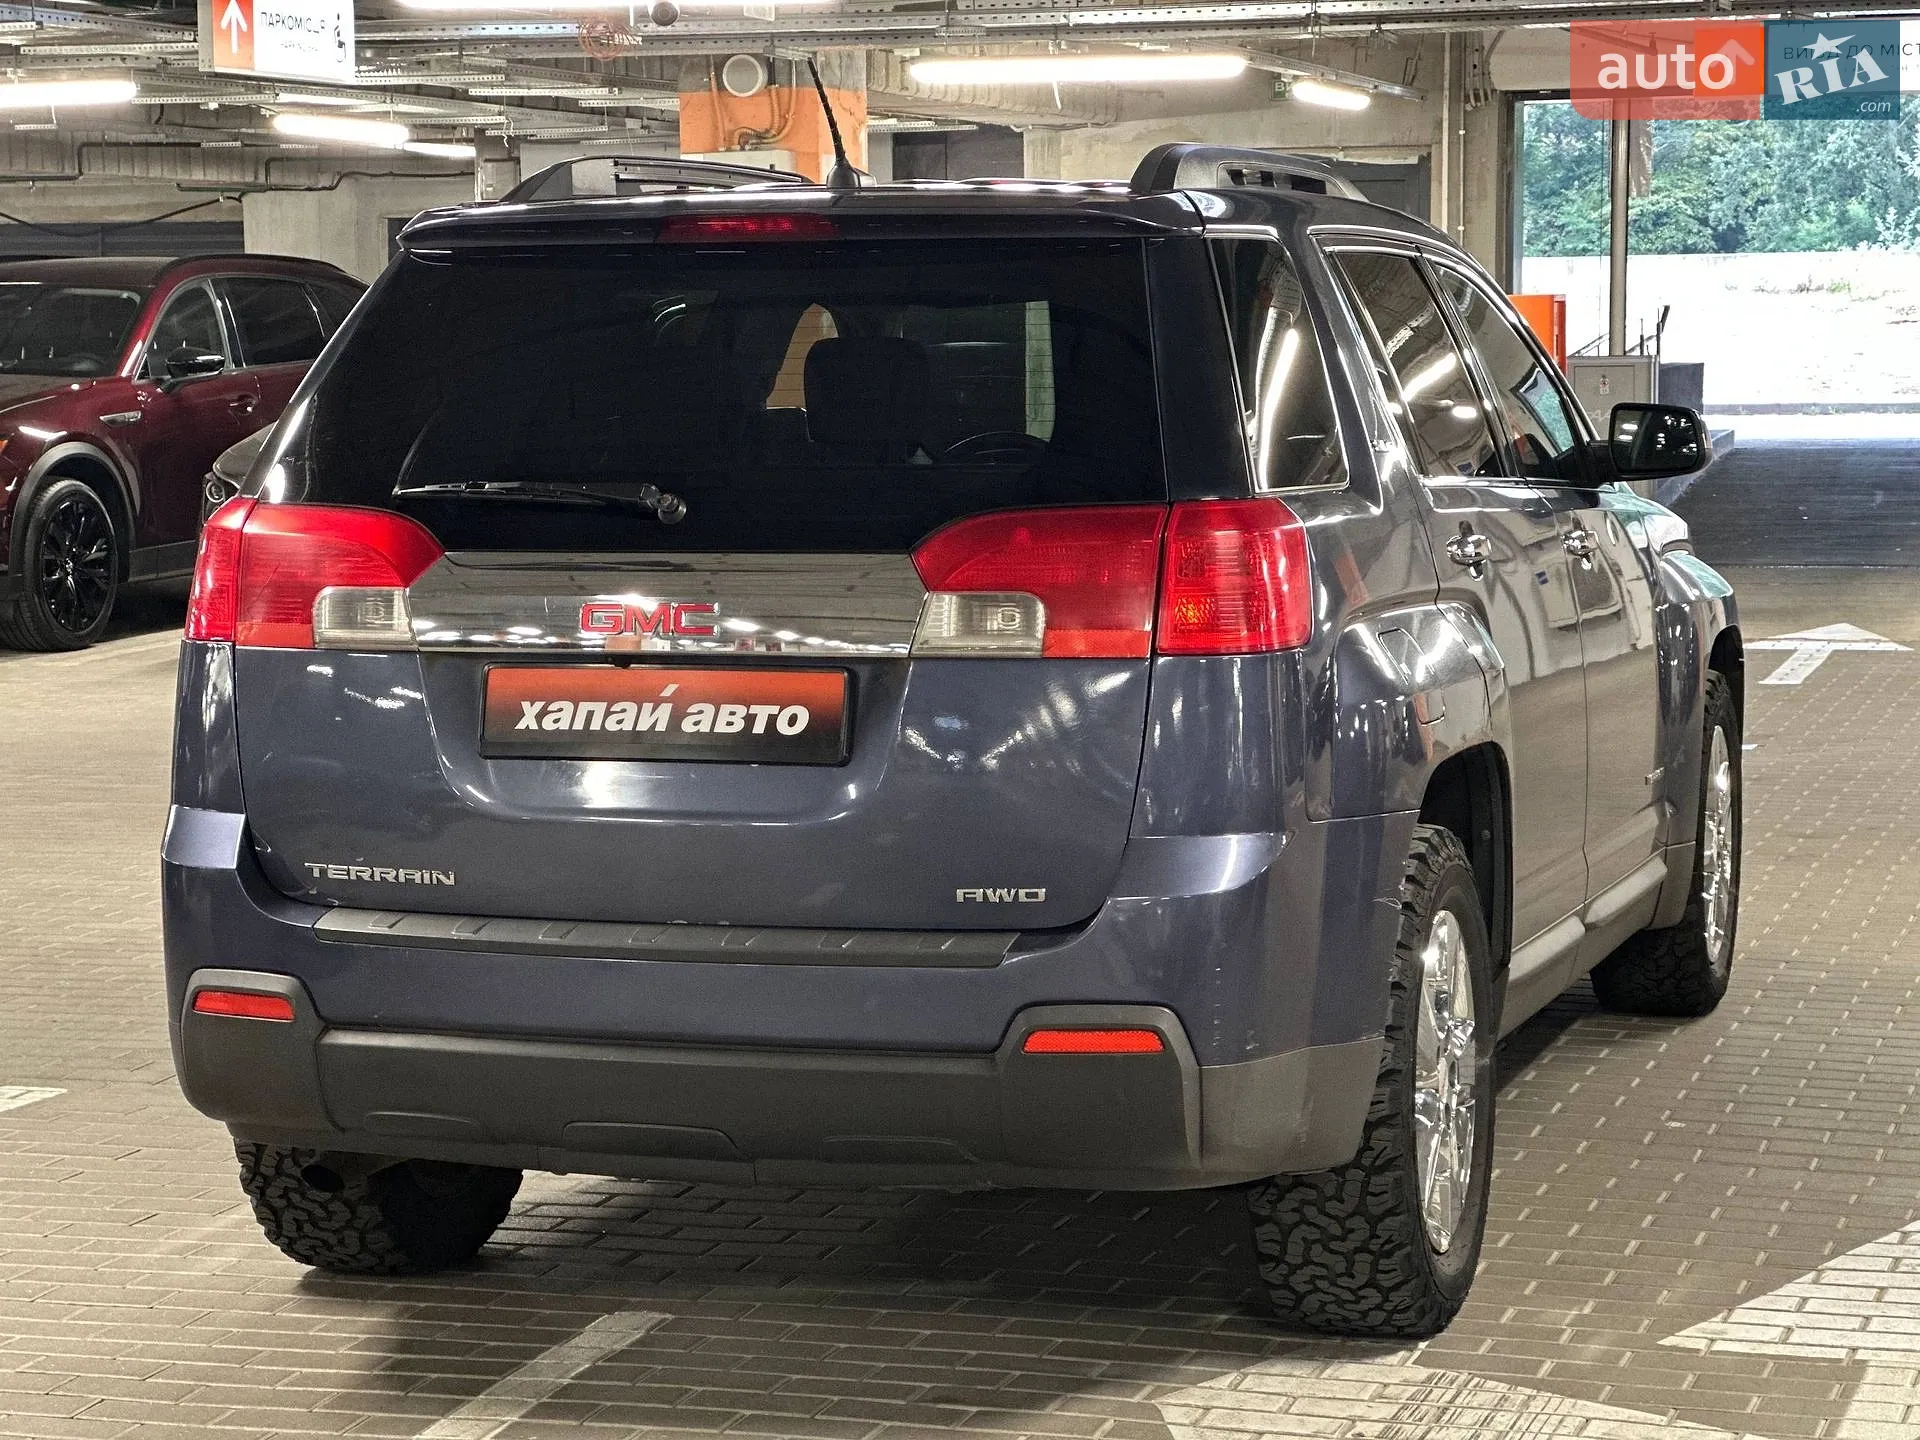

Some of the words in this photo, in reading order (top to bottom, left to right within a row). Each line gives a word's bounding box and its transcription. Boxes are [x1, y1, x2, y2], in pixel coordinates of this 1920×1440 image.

[260, 11, 325, 34] ПАРКОМІСЯ
[580, 601, 720, 636] GMC
[680, 702, 810, 736] авто
[304, 862, 455, 886] TERRAIN
[956, 887, 1047, 903] AWD
